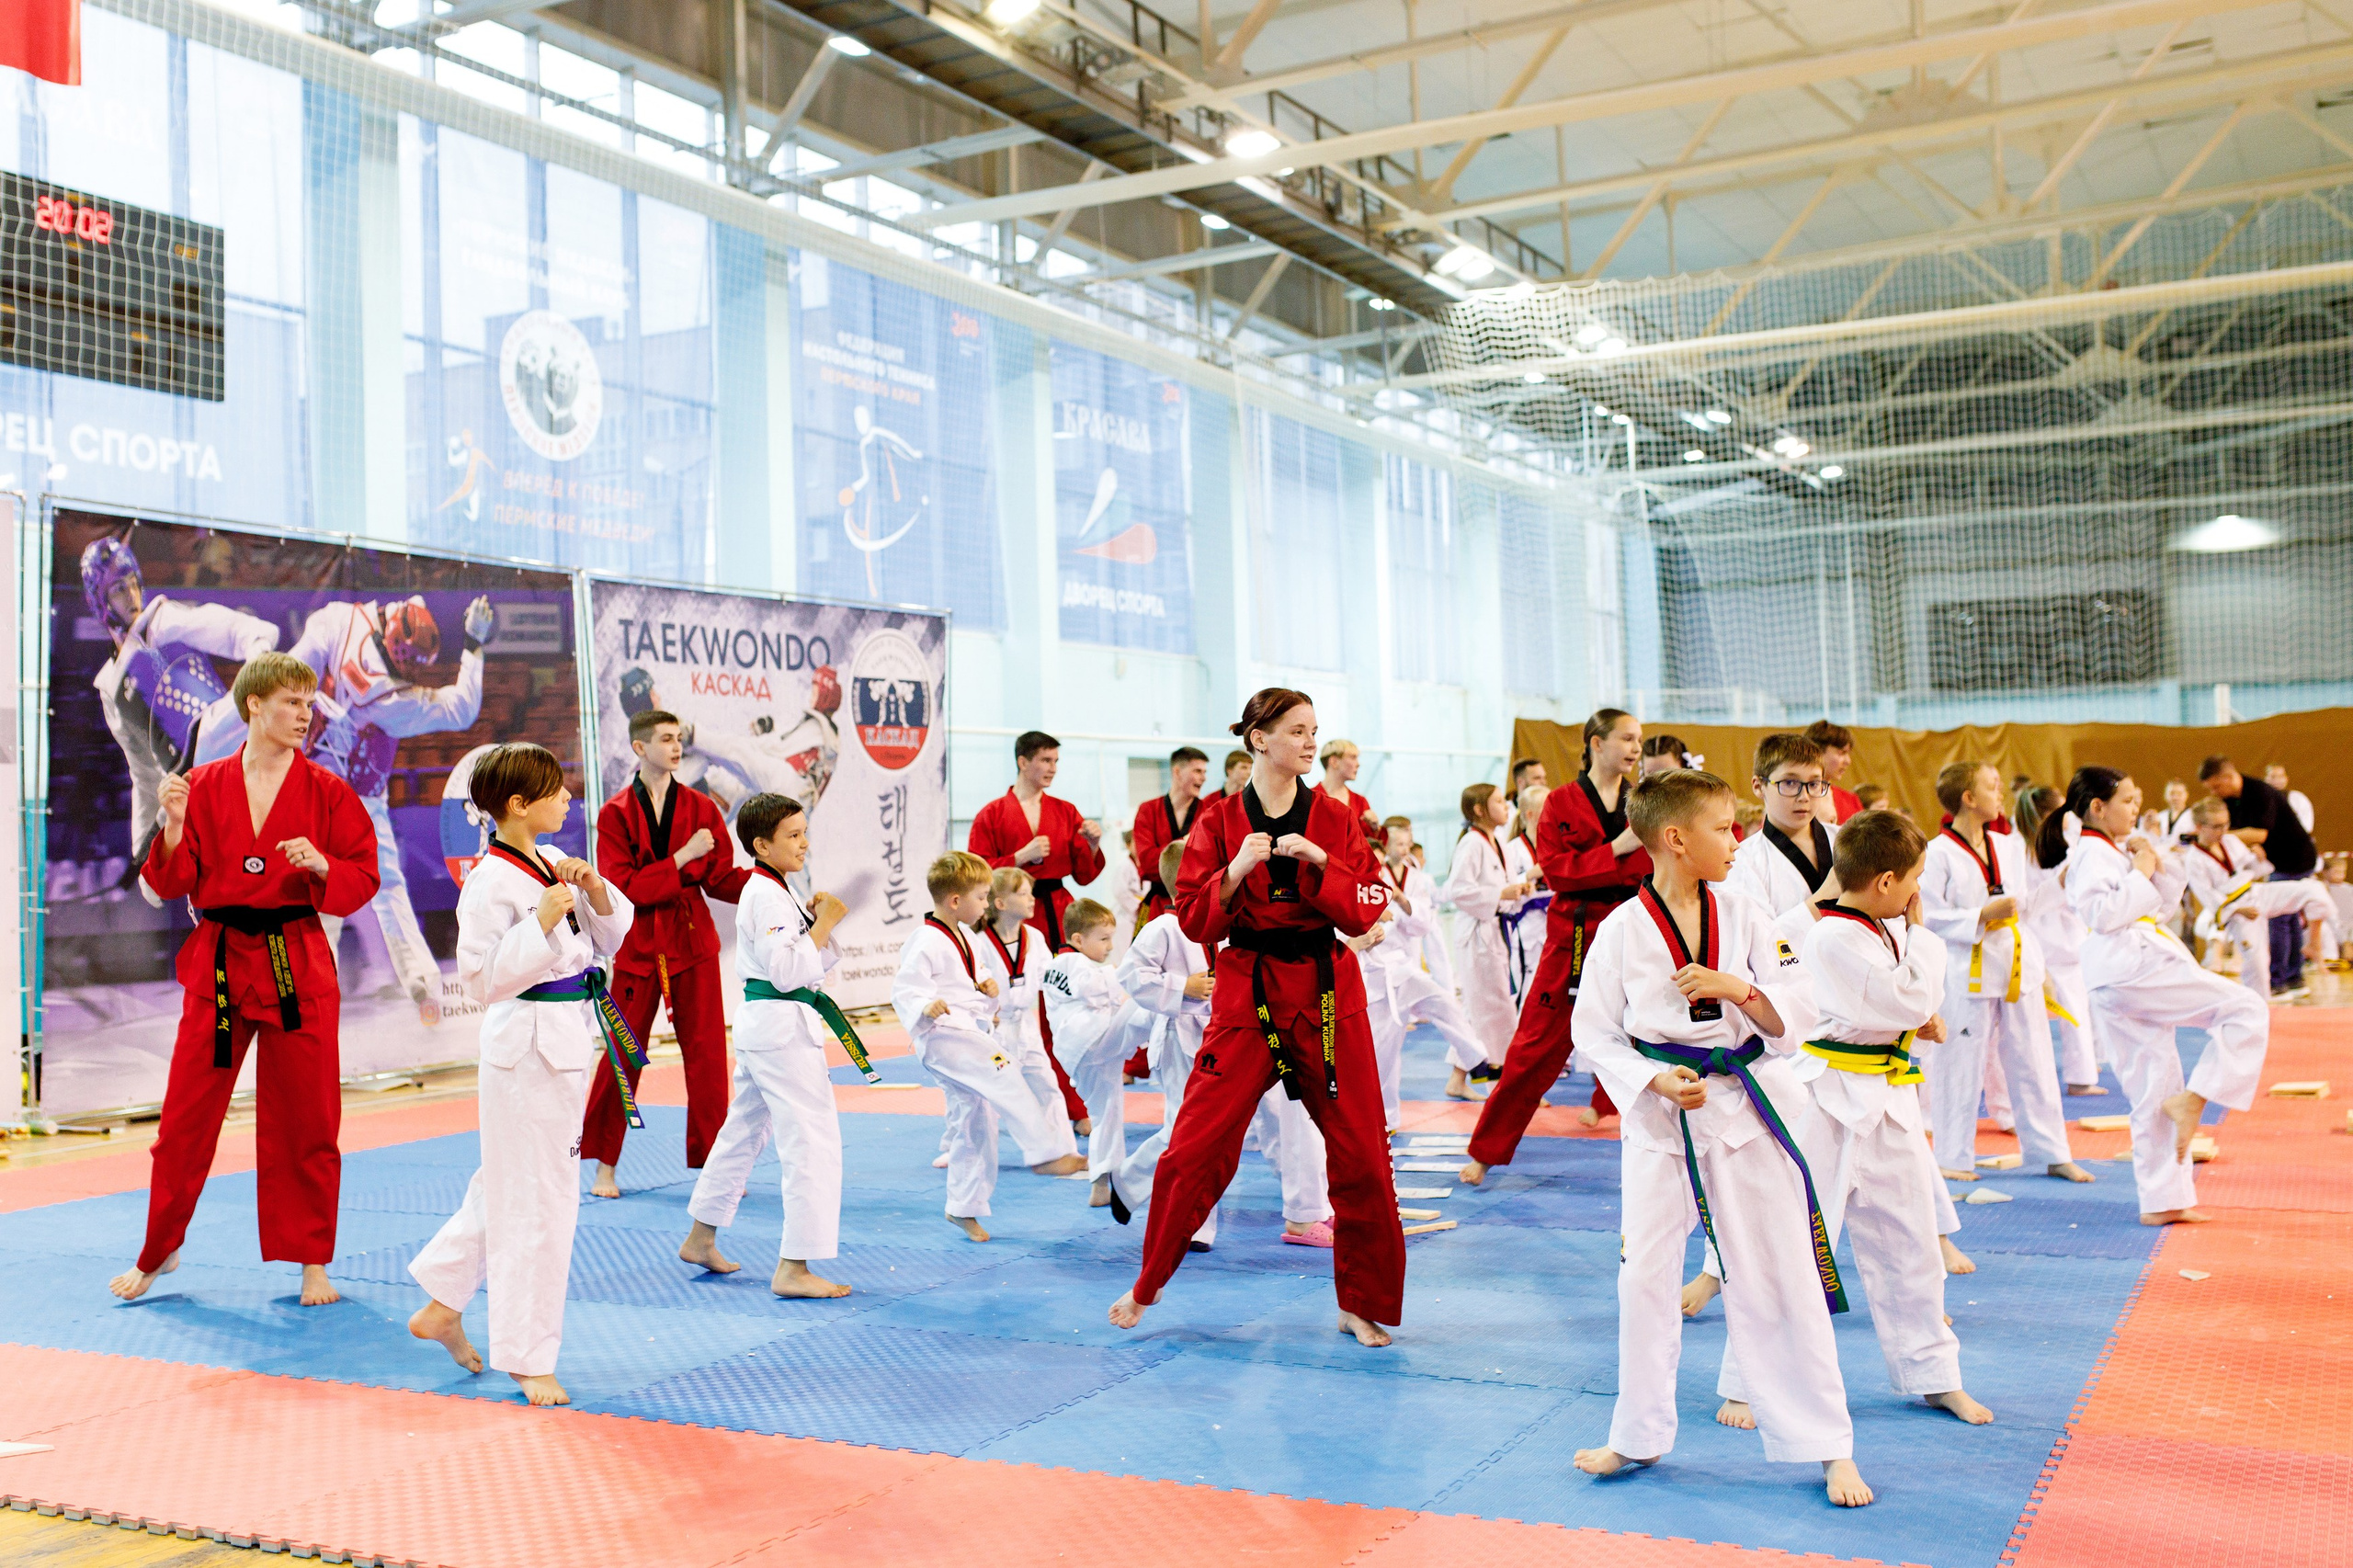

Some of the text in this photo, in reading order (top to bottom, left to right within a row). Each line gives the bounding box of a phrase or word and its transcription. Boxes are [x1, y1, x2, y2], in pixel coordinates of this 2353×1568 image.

[68, 423, 223, 483] СПОРТА
[619, 619, 831, 671] TAEKWONDO
[690, 671, 772, 702] КАСКАД
[599, 994, 640, 1054] TAEKWONDO
[841, 1031, 869, 1070] RUSSIA
[1321, 994, 1331, 1062] POLINA KUDRINA
[1812, 1210, 1840, 1292] TAEKWONDO
